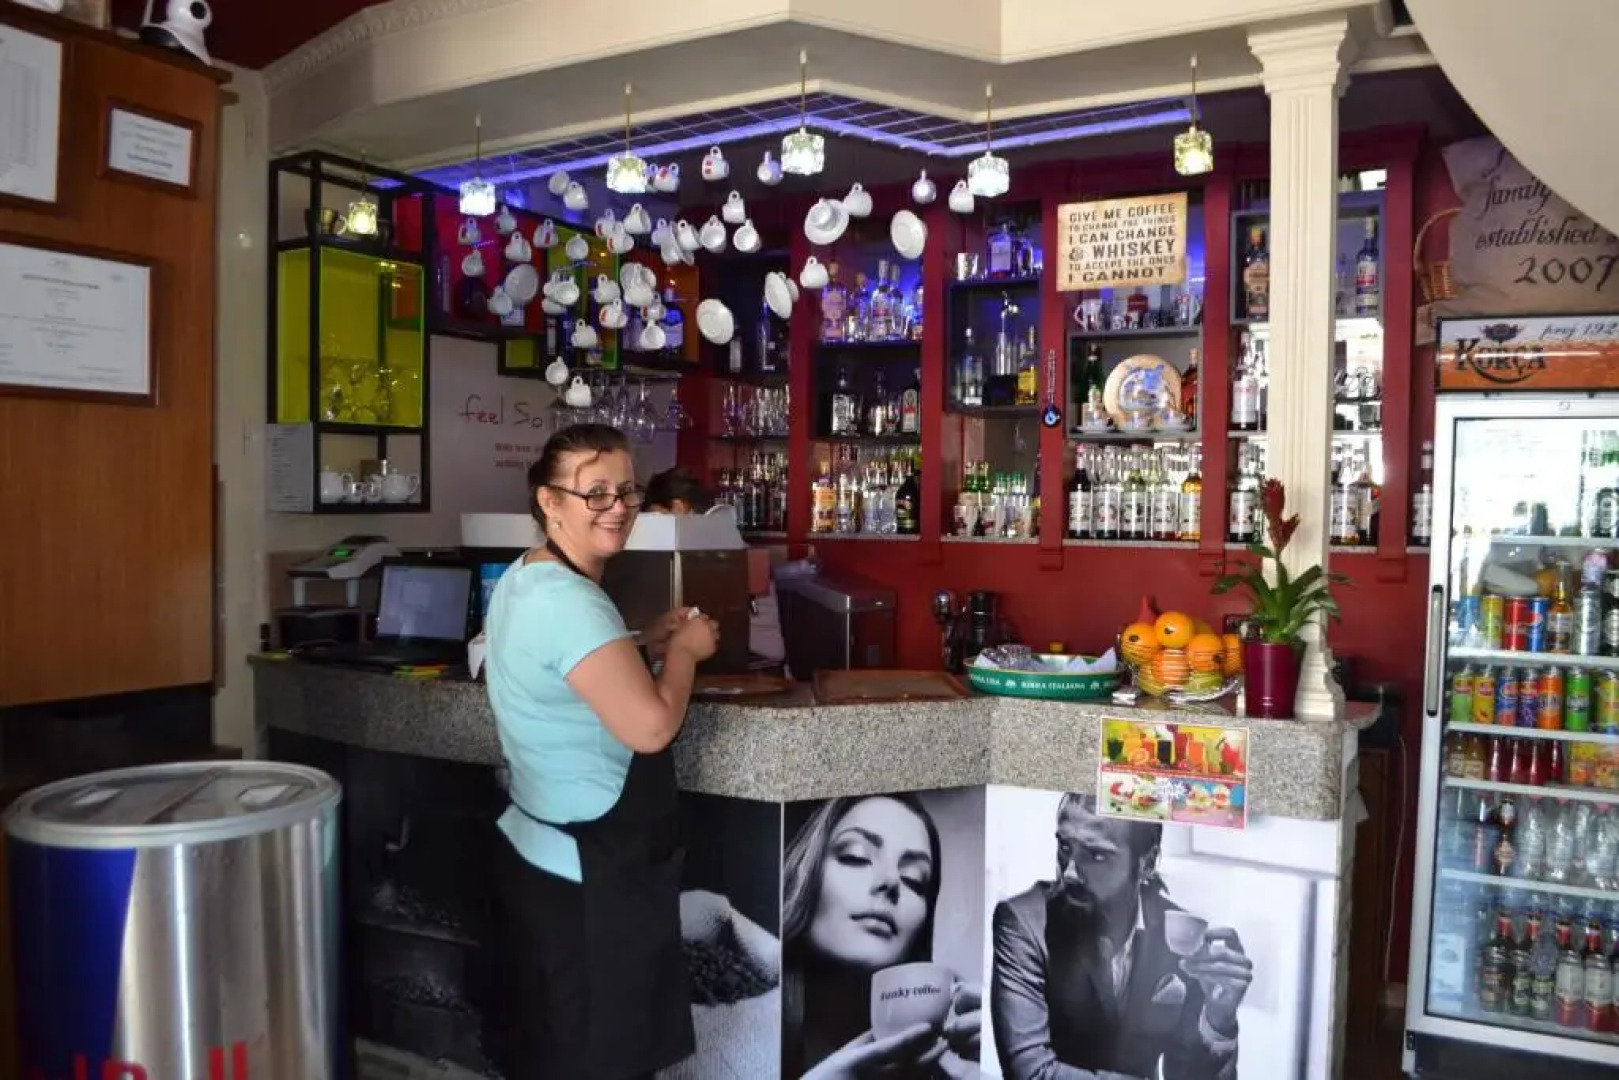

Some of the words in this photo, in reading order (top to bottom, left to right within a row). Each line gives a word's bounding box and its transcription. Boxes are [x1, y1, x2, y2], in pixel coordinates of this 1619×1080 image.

[1476, 175, 1551, 221] family
[1069, 212, 1097, 223] GIVE
[1104, 208, 1121, 219] ME
[1128, 202, 1176, 218] COFFEE
[1079, 232, 1109, 244] CAN
[1115, 225, 1176, 241] CHANGE
[1083, 221, 1119, 232] CHANGE
[1475, 215, 1600, 250] established
[1069, 247, 1084, 262] &
[1093, 239, 1176, 259] WHISKEY
[1069, 263, 1081, 272] TO
[1085, 260, 1122, 271] ACCEPT
[1083, 267, 1165, 282] CANNOT
[1513, 254, 1619, 292] 2007
[460, 393, 504, 425] feel
[880, 986, 910, 1001] funky
[913, 984, 941, 996] coffee
